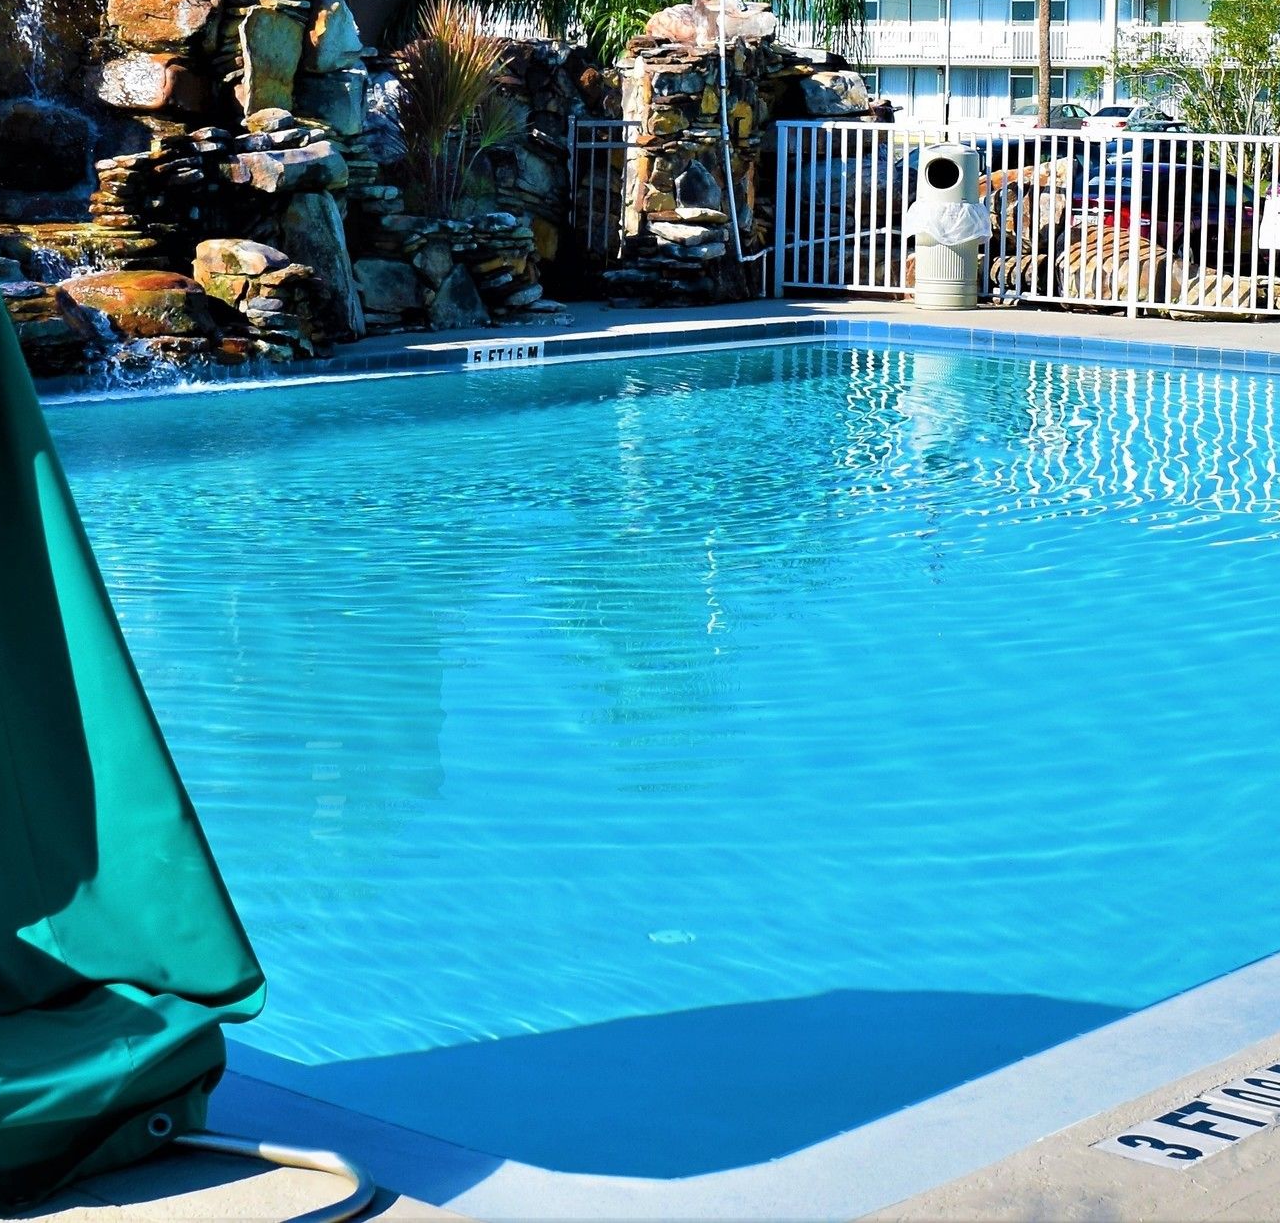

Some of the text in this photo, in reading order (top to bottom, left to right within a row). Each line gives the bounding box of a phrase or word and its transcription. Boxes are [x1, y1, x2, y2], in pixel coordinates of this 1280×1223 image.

[527, 346, 538, 359] M
[1154, 1100, 1269, 1152] FT
[1117, 1134, 1204, 1161] 3
